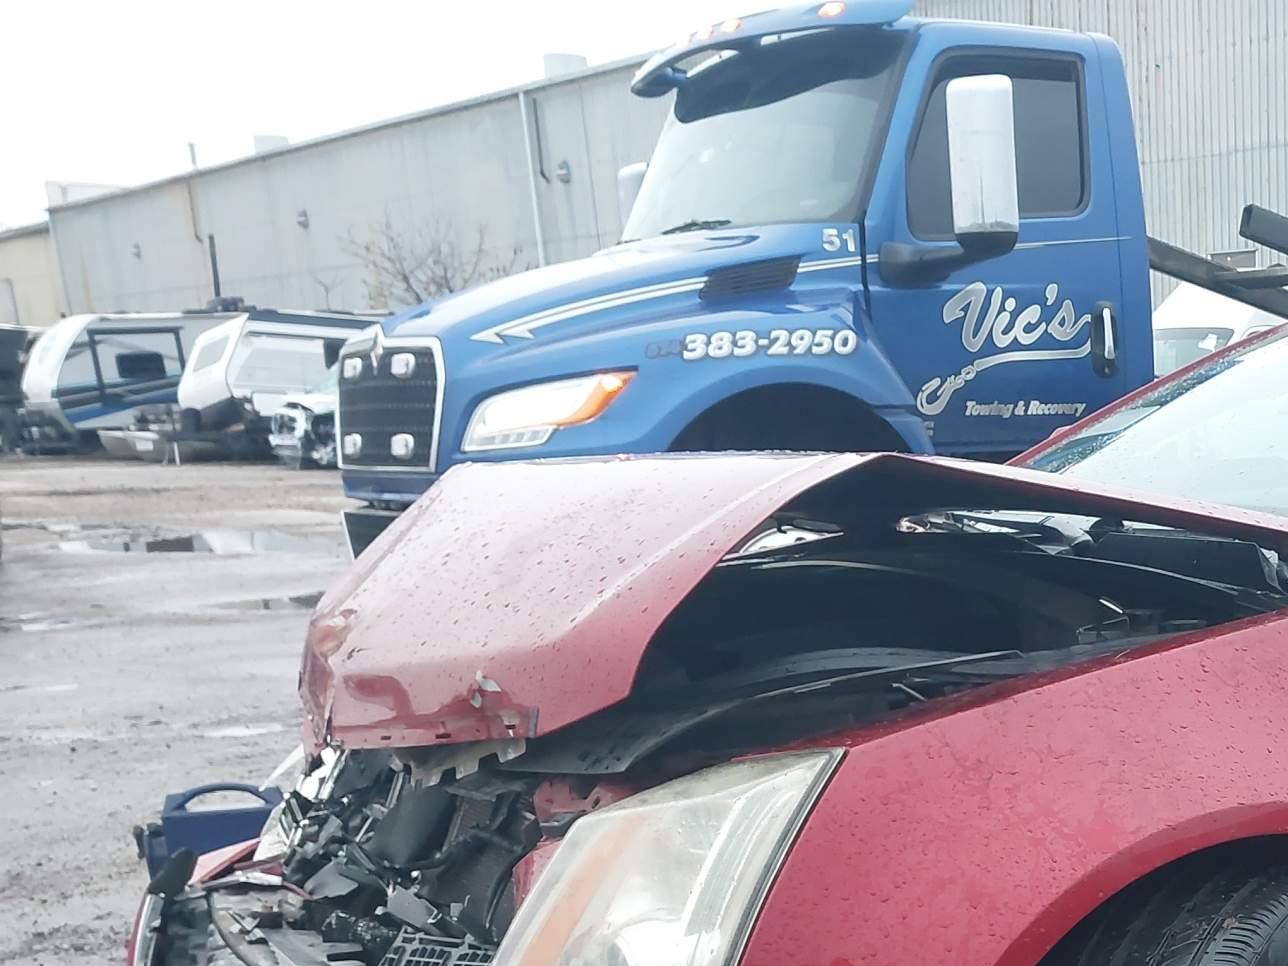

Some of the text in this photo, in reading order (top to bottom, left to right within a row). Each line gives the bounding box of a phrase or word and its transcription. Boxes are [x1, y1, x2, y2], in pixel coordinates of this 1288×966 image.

[822, 228, 856, 252] 51
[942, 281, 1092, 353] Vic's
[682, 328, 857, 361] 383-2950
[965, 400, 1087, 418] Towing & Recovery
